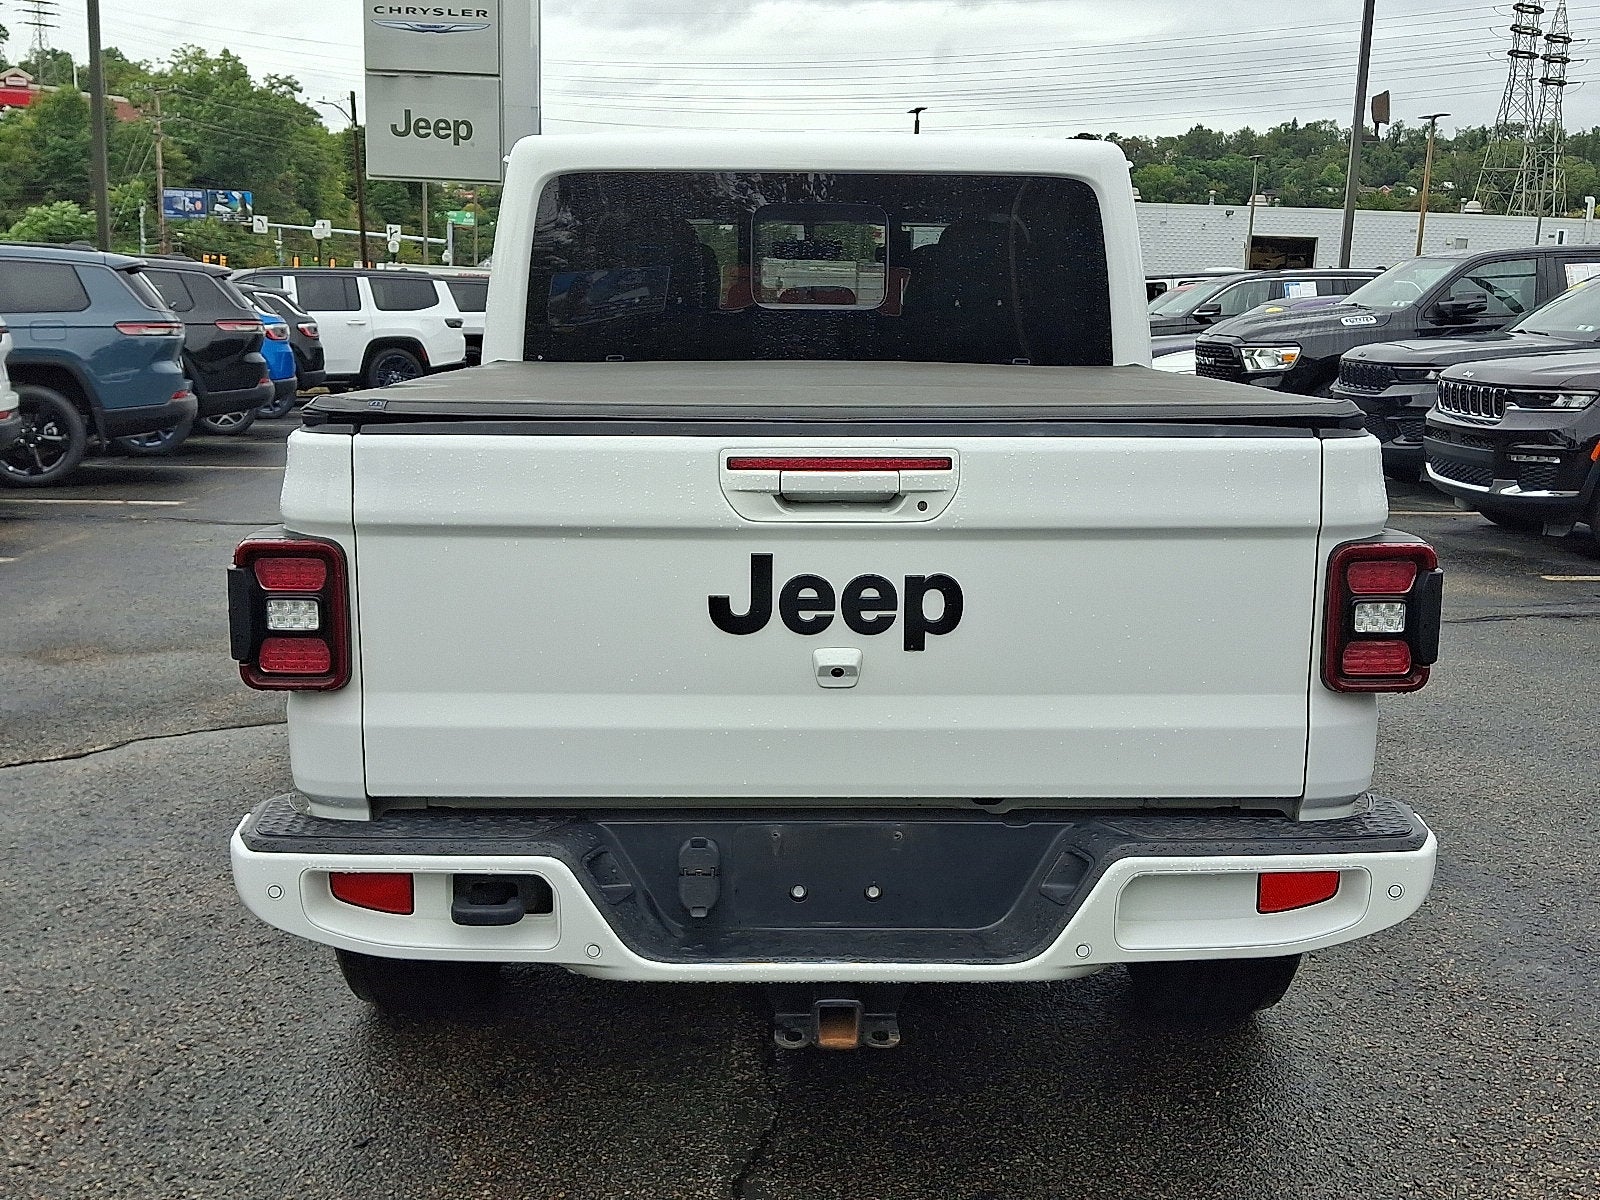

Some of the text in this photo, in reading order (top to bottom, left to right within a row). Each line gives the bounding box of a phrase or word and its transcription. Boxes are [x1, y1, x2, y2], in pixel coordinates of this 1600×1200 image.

[373, 5, 489, 18] CHRYSLER
[390, 108, 474, 146] Jeep
[707, 552, 964, 651] Jeep
